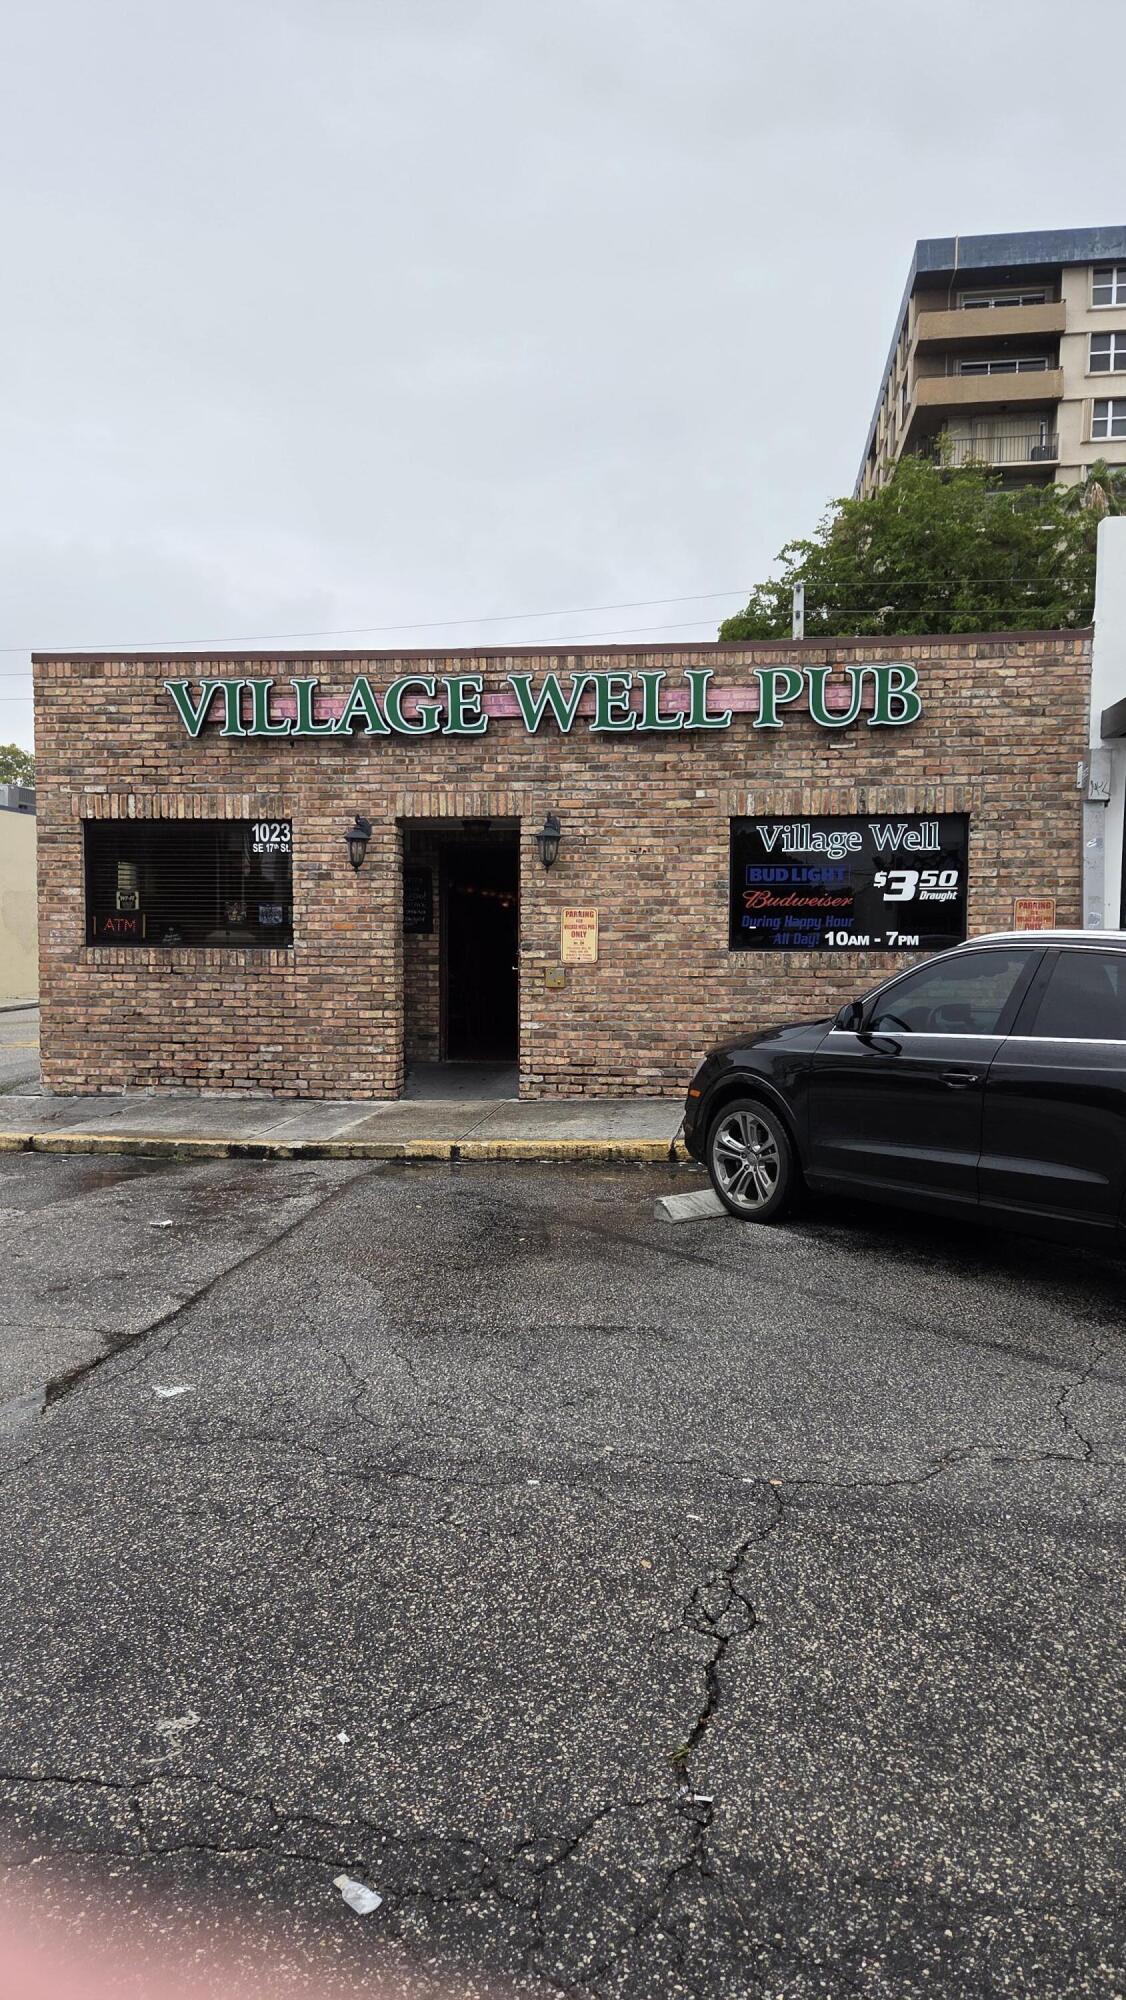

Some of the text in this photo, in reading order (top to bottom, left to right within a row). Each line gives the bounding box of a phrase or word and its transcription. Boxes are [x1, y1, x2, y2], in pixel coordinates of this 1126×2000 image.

[164, 663, 922, 737] VILLAGE WELL PUB
[252, 823, 291, 842] 1023
[756, 821, 941, 859] Village Well
[252, 843, 264, 852] SE
[266, 843, 279, 852] 17th
[749, 867, 846, 882] BUD LIGHT
[742, 890, 854, 909] Budweiser
[919, 890, 958, 902] Draught
[1018, 901, 1051, 909] PARKING
[103, 918, 137, 933] ATM
[741, 915, 855, 930] During Happy Hour
[772, 931, 789, 945] All
[793, 931, 821, 947] Day!
[824, 931, 870, 946] 10AM
[885, 931, 919, 946] 7PM
